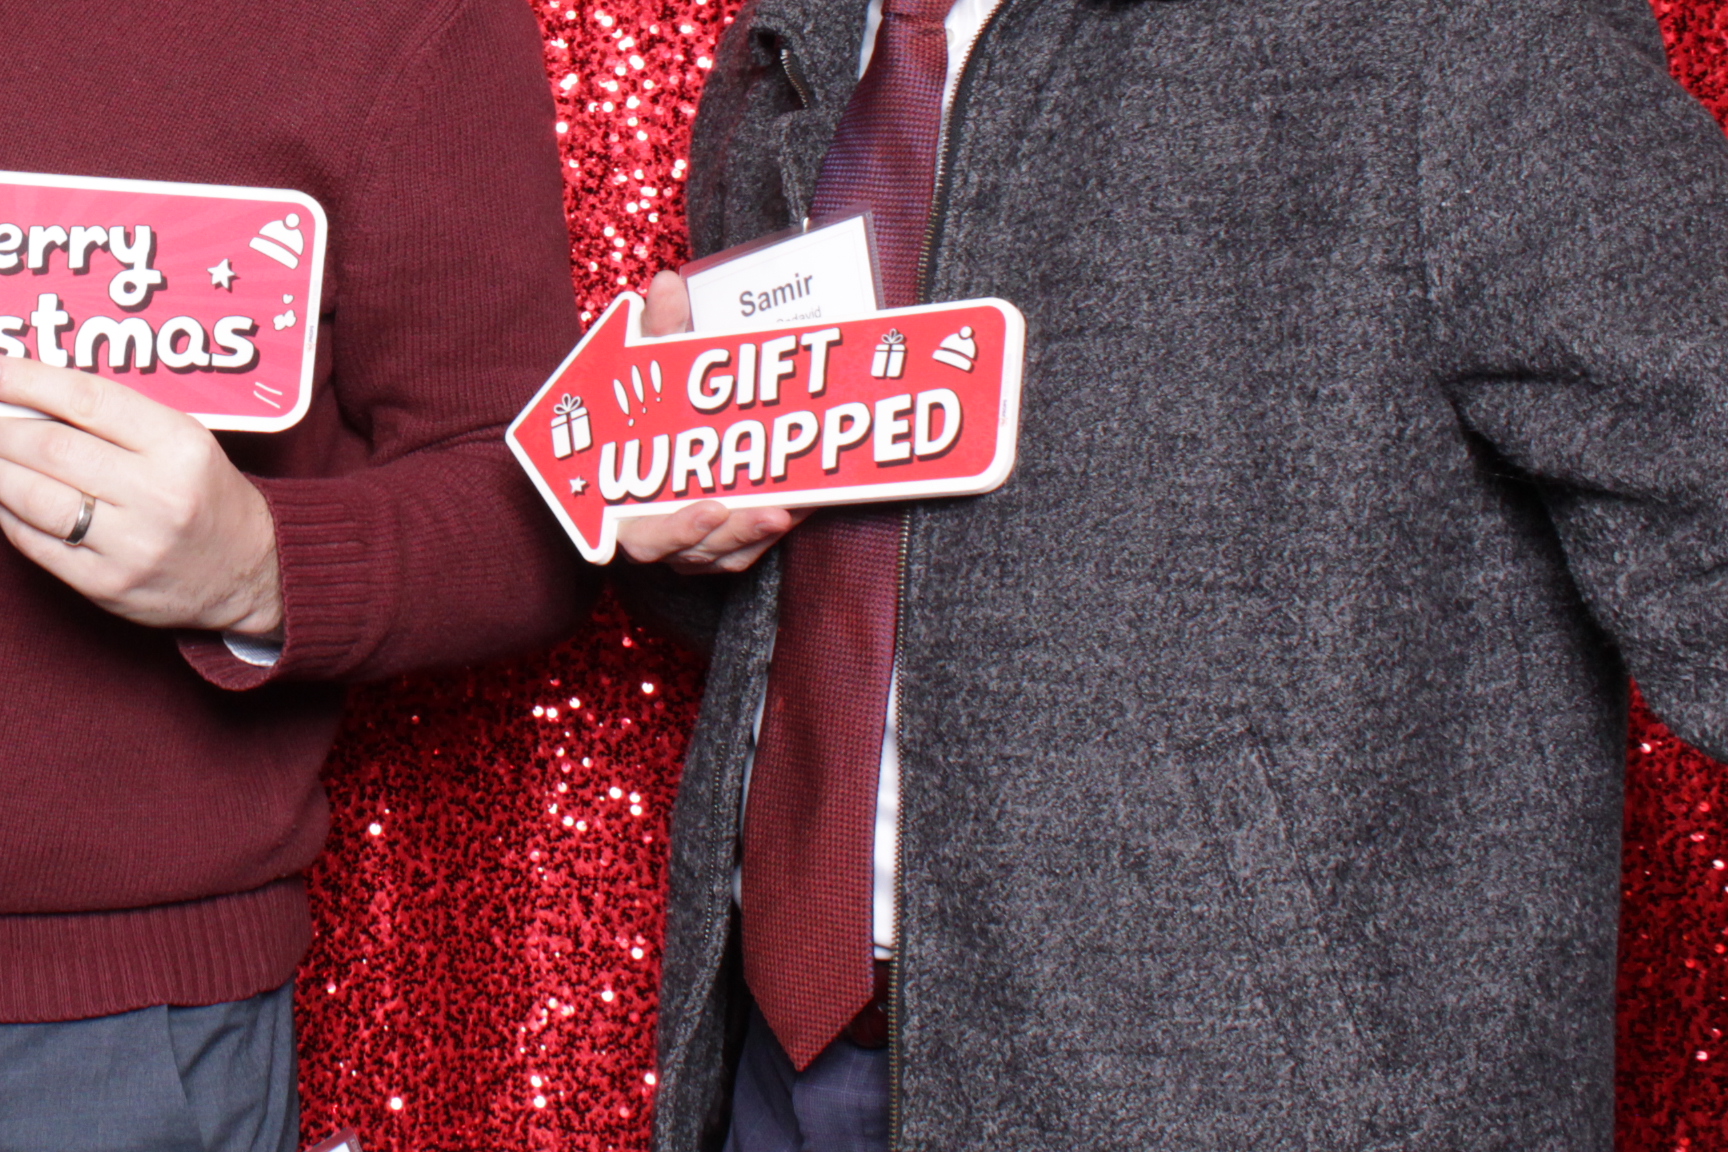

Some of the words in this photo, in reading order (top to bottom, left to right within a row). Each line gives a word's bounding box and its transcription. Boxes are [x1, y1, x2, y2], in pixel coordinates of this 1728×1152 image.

[739, 271, 814, 318] Samir
[686, 327, 842, 412] GIFT
[597, 387, 963, 504] WRAPPED
